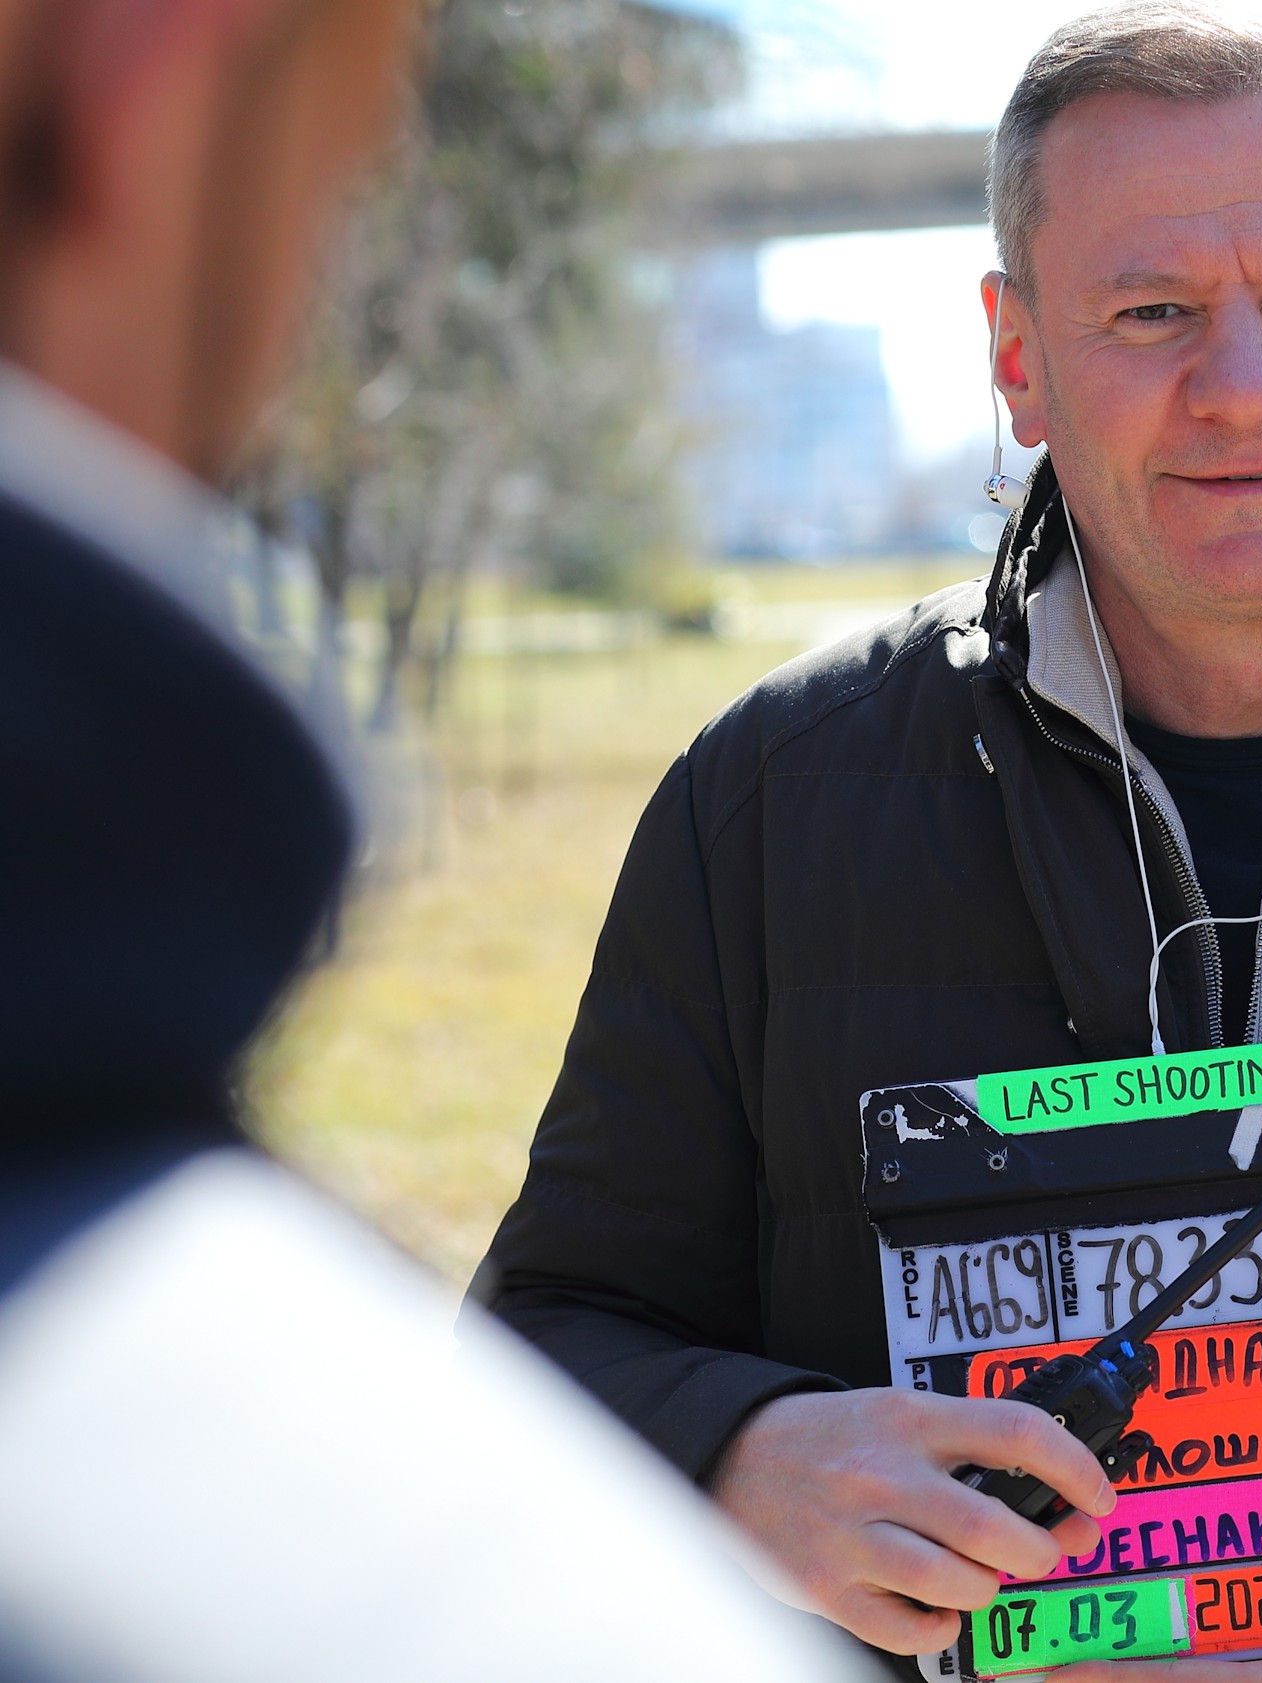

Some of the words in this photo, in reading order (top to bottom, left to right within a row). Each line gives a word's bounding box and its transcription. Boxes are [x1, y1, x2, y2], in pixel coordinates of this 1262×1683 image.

[1003, 1072, 1098, 1121] LAST
[901, 1251, 921, 1319] ROLL
[928, 1238, 1049, 1344] A669
[1057, 1232, 1079, 1317] SCENE
